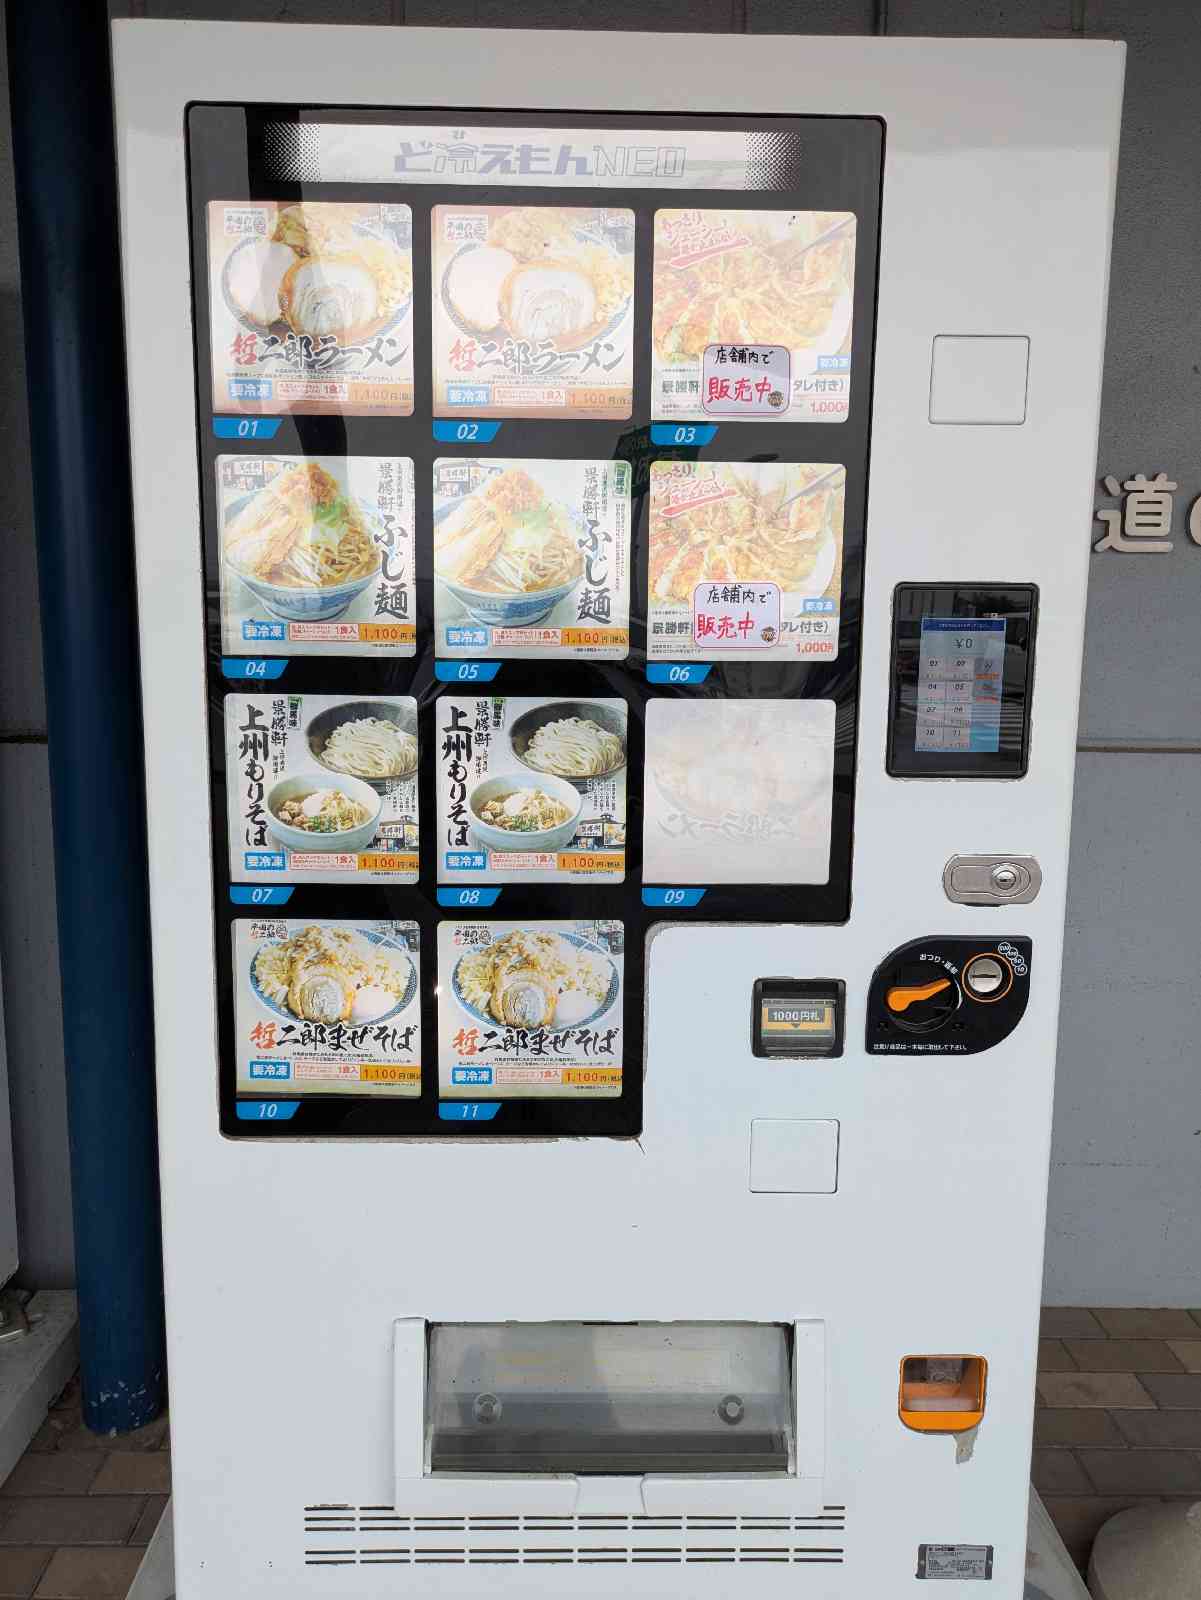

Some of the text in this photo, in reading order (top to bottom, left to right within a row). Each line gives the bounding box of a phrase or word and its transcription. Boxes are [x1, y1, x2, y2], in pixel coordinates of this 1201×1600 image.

[230, 331, 409, 369] 哲二郎ラーメン
[449, 338, 625, 375] 哲二郎ラーメン
[715, 346, 774, 364] 店舗内で
[706, 376, 773, 403] 販売中
[238, 420, 258, 436] 01
[457, 424, 479, 440] 02
[674, 428, 695, 443] 03
[1094, 472, 1201, 552] 道
[374, 514, 409, 620] ふじ麺
[577, 519, 613, 625] ふじ麺
[707, 584, 773, 604] 店舗内で
[245, 622, 283, 638] 要冷凍
[696, 610, 755, 640] 販売中
[245, 661, 267, 677] 04
[458, 664, 480, 680] 05
[669, 666, 691, 682] 06
[238, 703, 270, 847] 上州もりそば
[442, 705, 473, 847] 上州もりそば
[246, 854, 285, 868] 要冷凍
[447, 854, 485, 868] 要冷凍
[251, 888, 274, 903] 07
[459, 889, 481, 905] 08
[664, 889, 685, 905] 09
[773, 1010, 820, 1022] 1000円札
[249, 1021, 419, 1053] 哲二郎まぜそば
[452, 1027, 621, 1056] 哲二郎まぜそば
[252, 1063, 288, 1077] 要冷凍
[454, 1071, 490, 1083] 要冷凍
[259, 1103, 278, 1118] 10
[462, 1103, 479, 1119] 11
